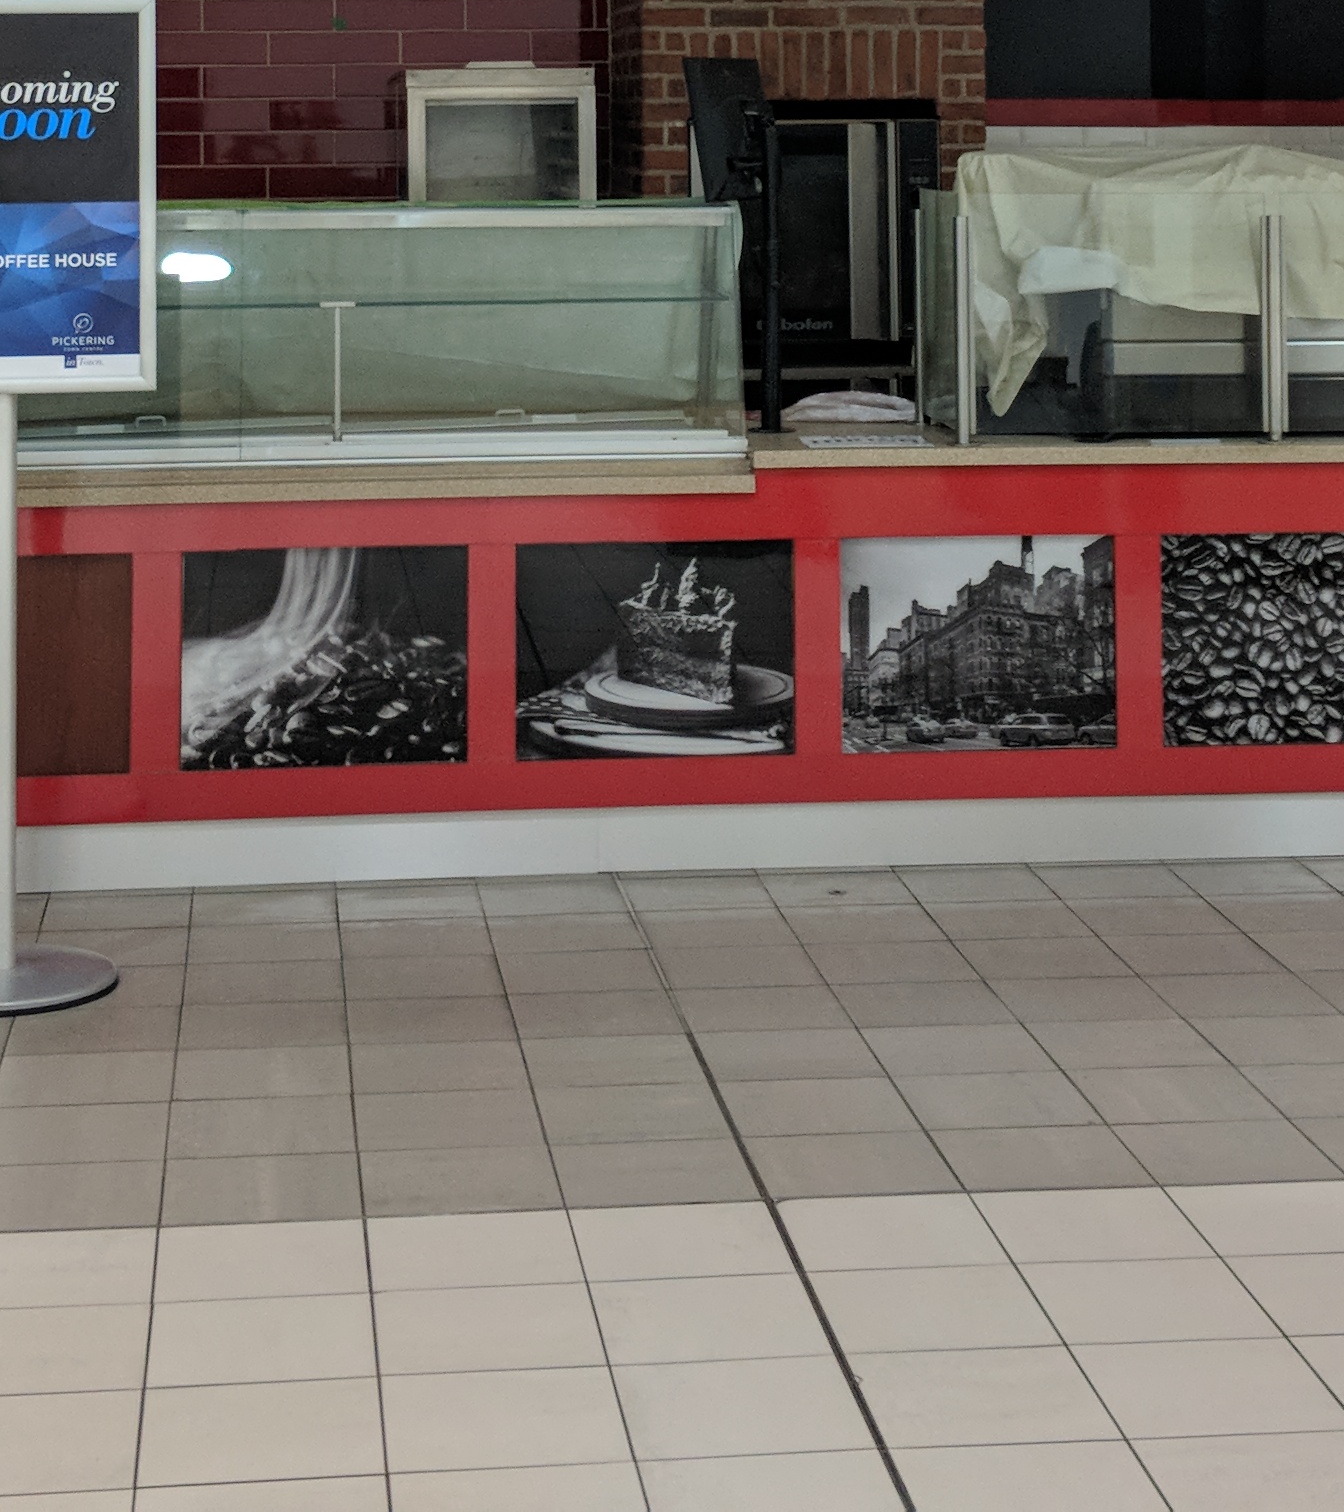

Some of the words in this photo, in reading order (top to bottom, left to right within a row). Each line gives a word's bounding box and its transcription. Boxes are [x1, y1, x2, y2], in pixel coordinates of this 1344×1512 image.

[55, 252, 118, 268] HOUSE
[756, 317, 834, 331] tbofan
[51, 335, 115, 346] PICKERING
